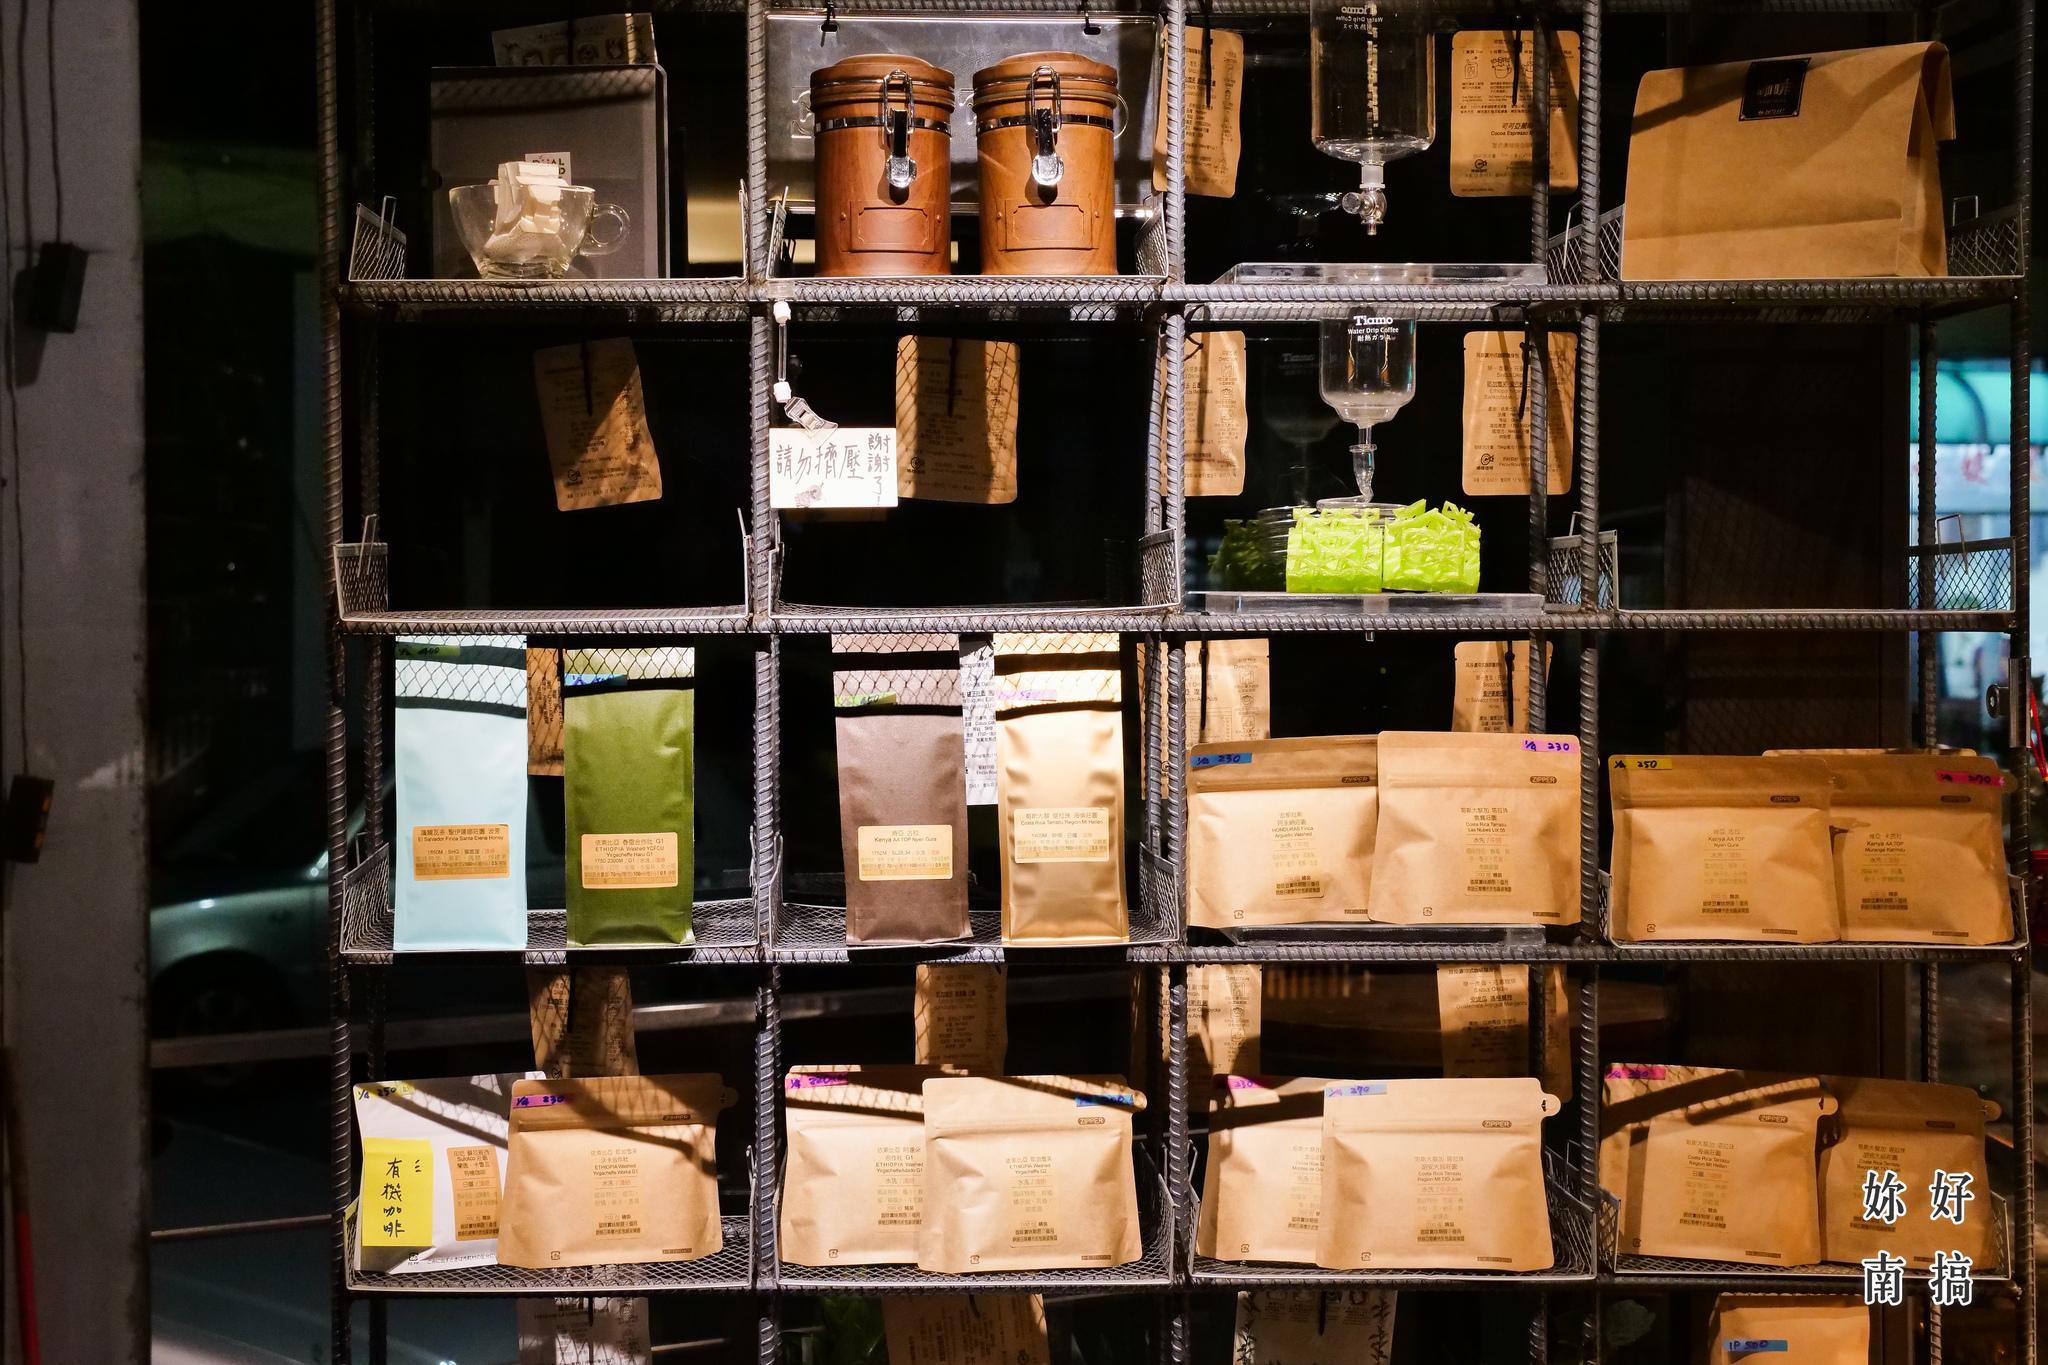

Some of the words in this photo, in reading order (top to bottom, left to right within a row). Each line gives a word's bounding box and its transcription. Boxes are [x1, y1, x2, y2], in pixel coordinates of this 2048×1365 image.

[1354, 315, 1393, 326] Tiamo
[1348, 327, 1365, 335] Water
[1381, 326, 1399, 334] Coffee
[776, 442, 864, 485] 請勿擠壓
[1547, 742, 1570, 751] 230
[1218, 755, 1241, 763] 230
[1637, 760, 1657, 768] 250
[543, 1095, 565, 1104] 230
[381, 1157, 405, 1237] 有機咖啡
[1744, 1341, 1769, 1350] 500
